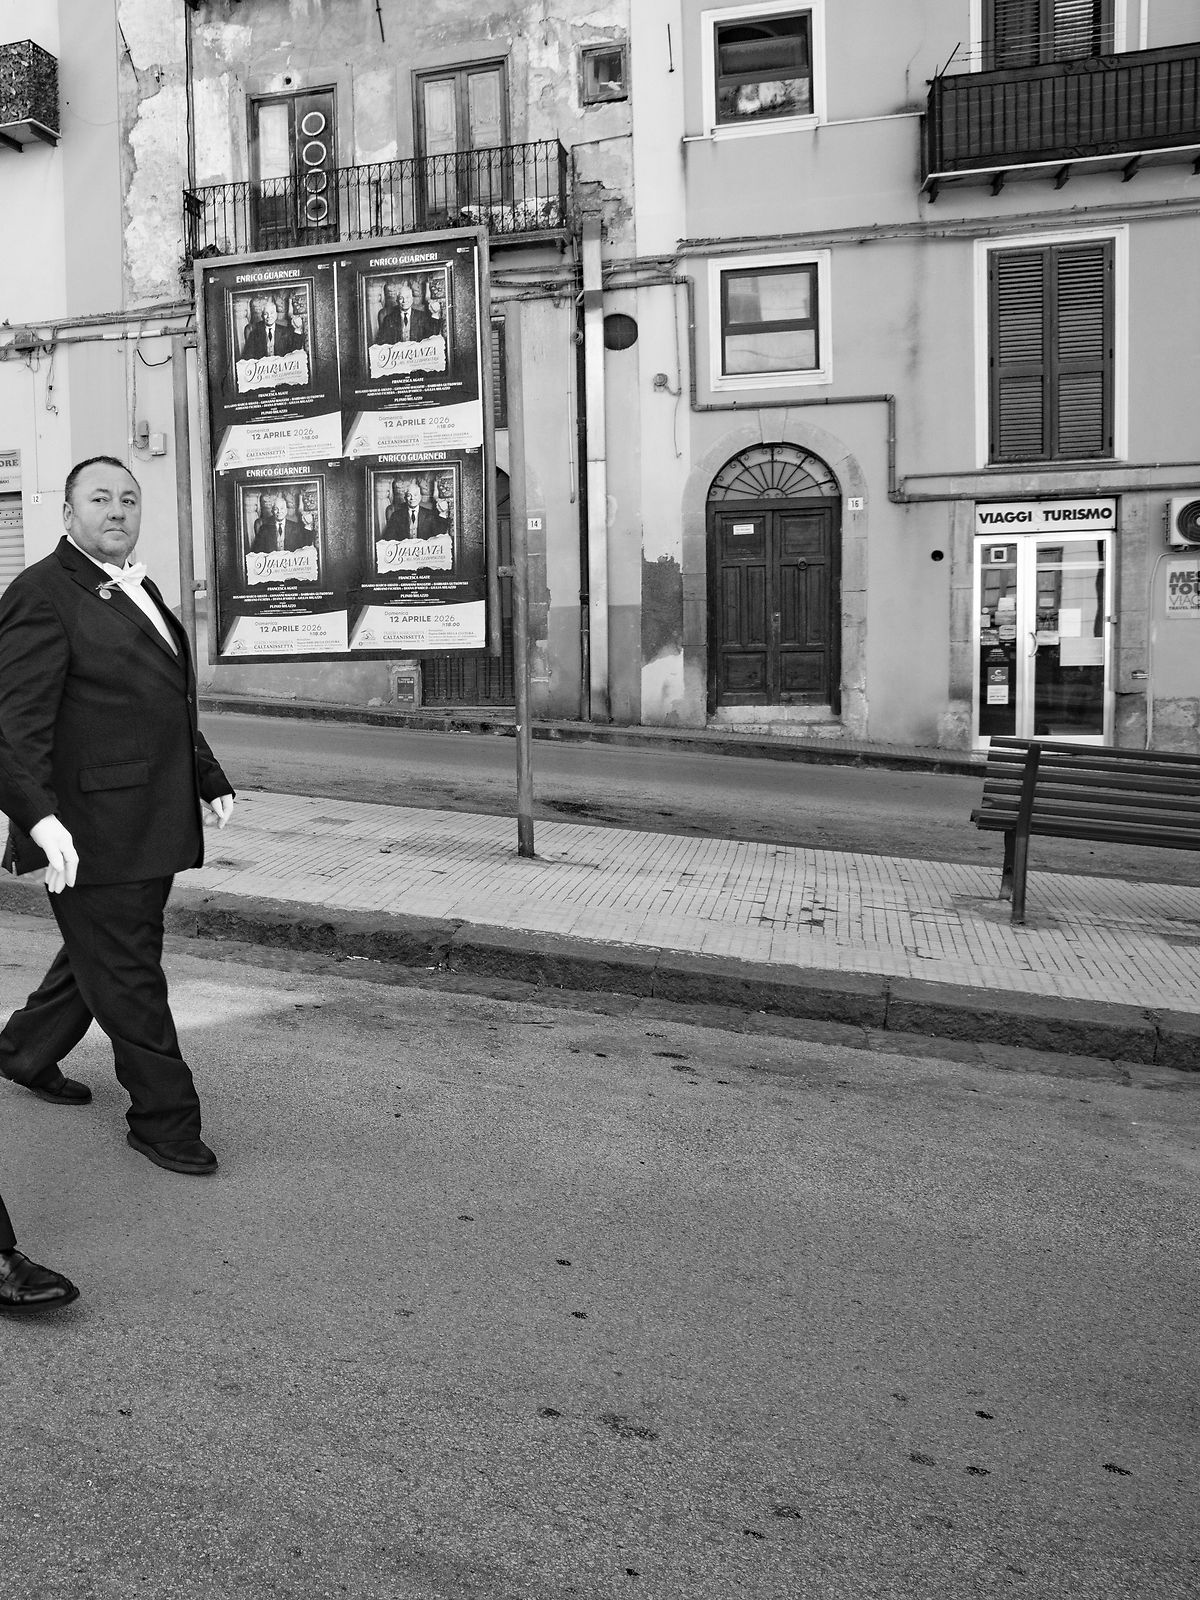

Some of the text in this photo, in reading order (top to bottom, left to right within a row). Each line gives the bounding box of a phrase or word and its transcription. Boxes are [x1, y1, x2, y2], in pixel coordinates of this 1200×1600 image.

[370, 252, 438, 267] ENRICO GUARNERI
[236, 269, 301, 283] ENRICO GUARNERI
[397, 418, 426, 427] APRILE
[428, 416, 450, 425] 2026
[252, 428, 314, 441] 12 APRILE 2026
[378, 450, 447, 463] ENRICO GUARNERI
[246, 465, 311, 478] ENRICO GUARNERI
[851, 500, 859, 508] 16
[979, 507, 1112, 524] VIAGGI TURISMO
[531, 520, 538, 528] 14
[301, 624, 321, 632] 2026
